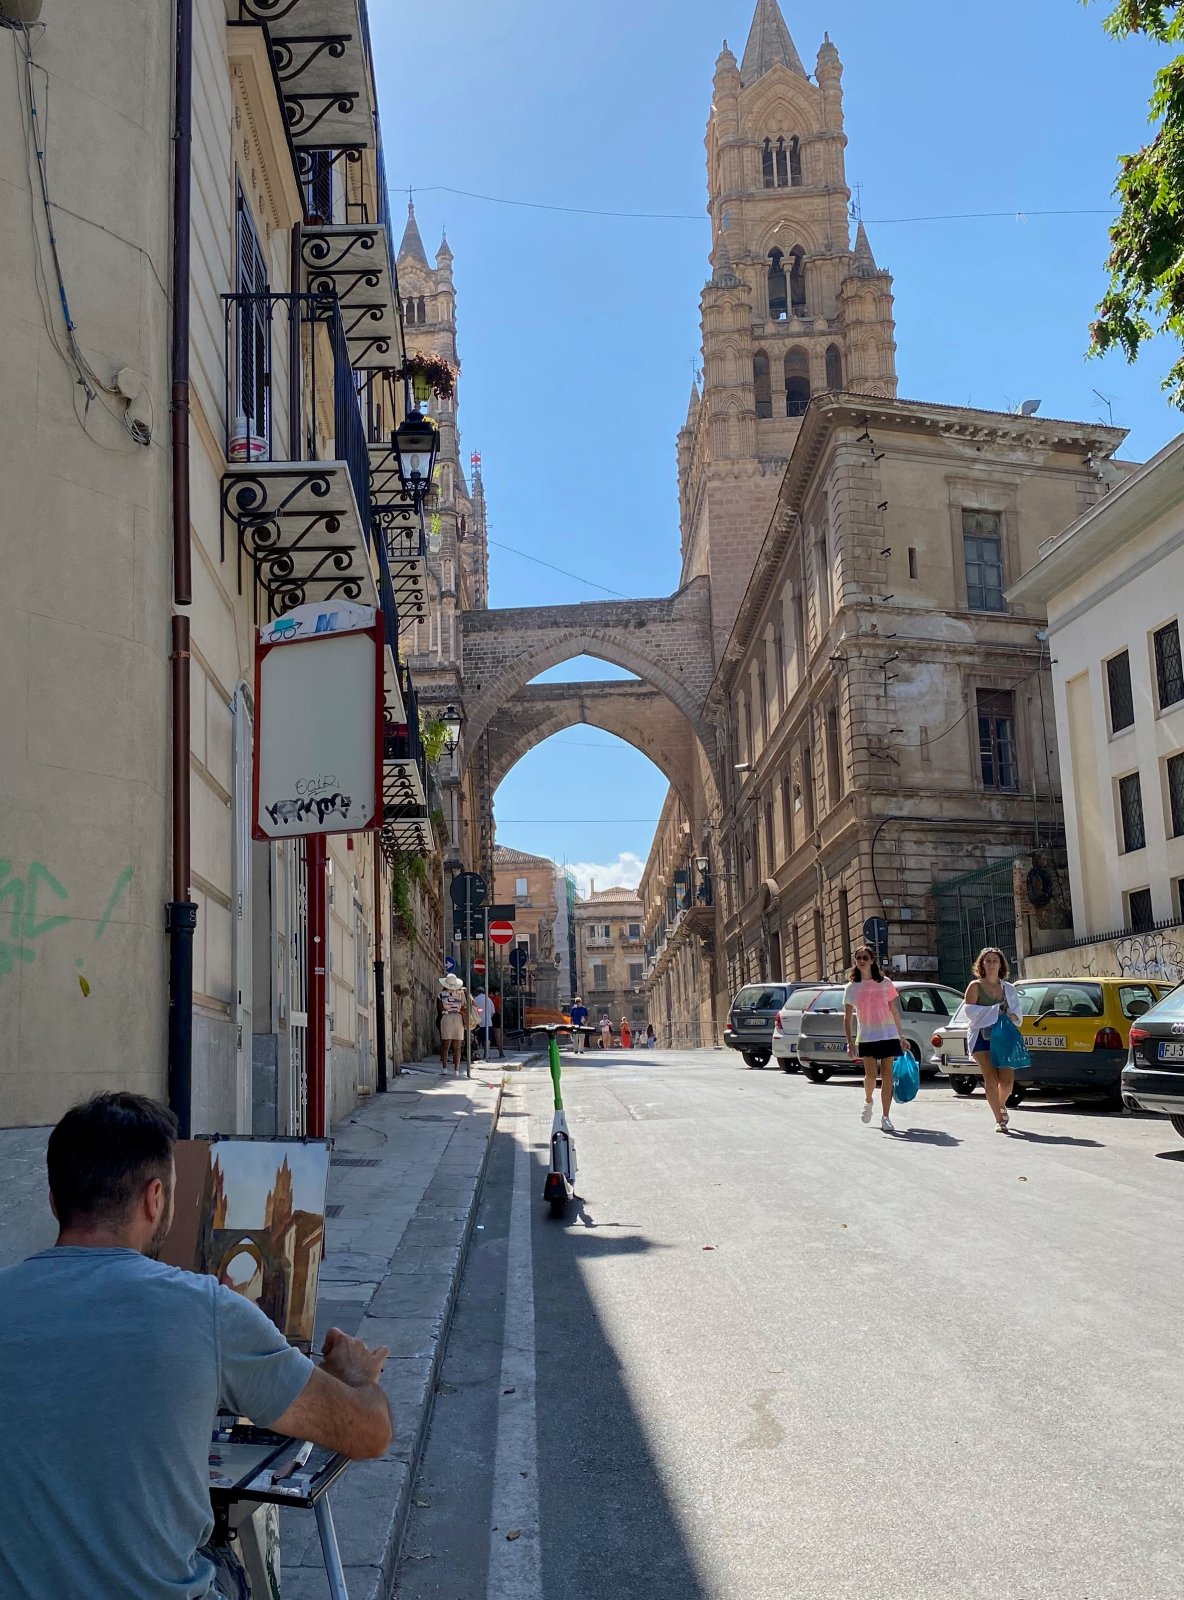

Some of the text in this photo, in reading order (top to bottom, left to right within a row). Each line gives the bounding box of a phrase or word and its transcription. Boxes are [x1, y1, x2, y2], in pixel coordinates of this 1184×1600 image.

[1024, 1036, 1034, 1046] AD
[1037, 1037, 1052, 1046] 546
[1054, 1037, 1065, 1047] DK
